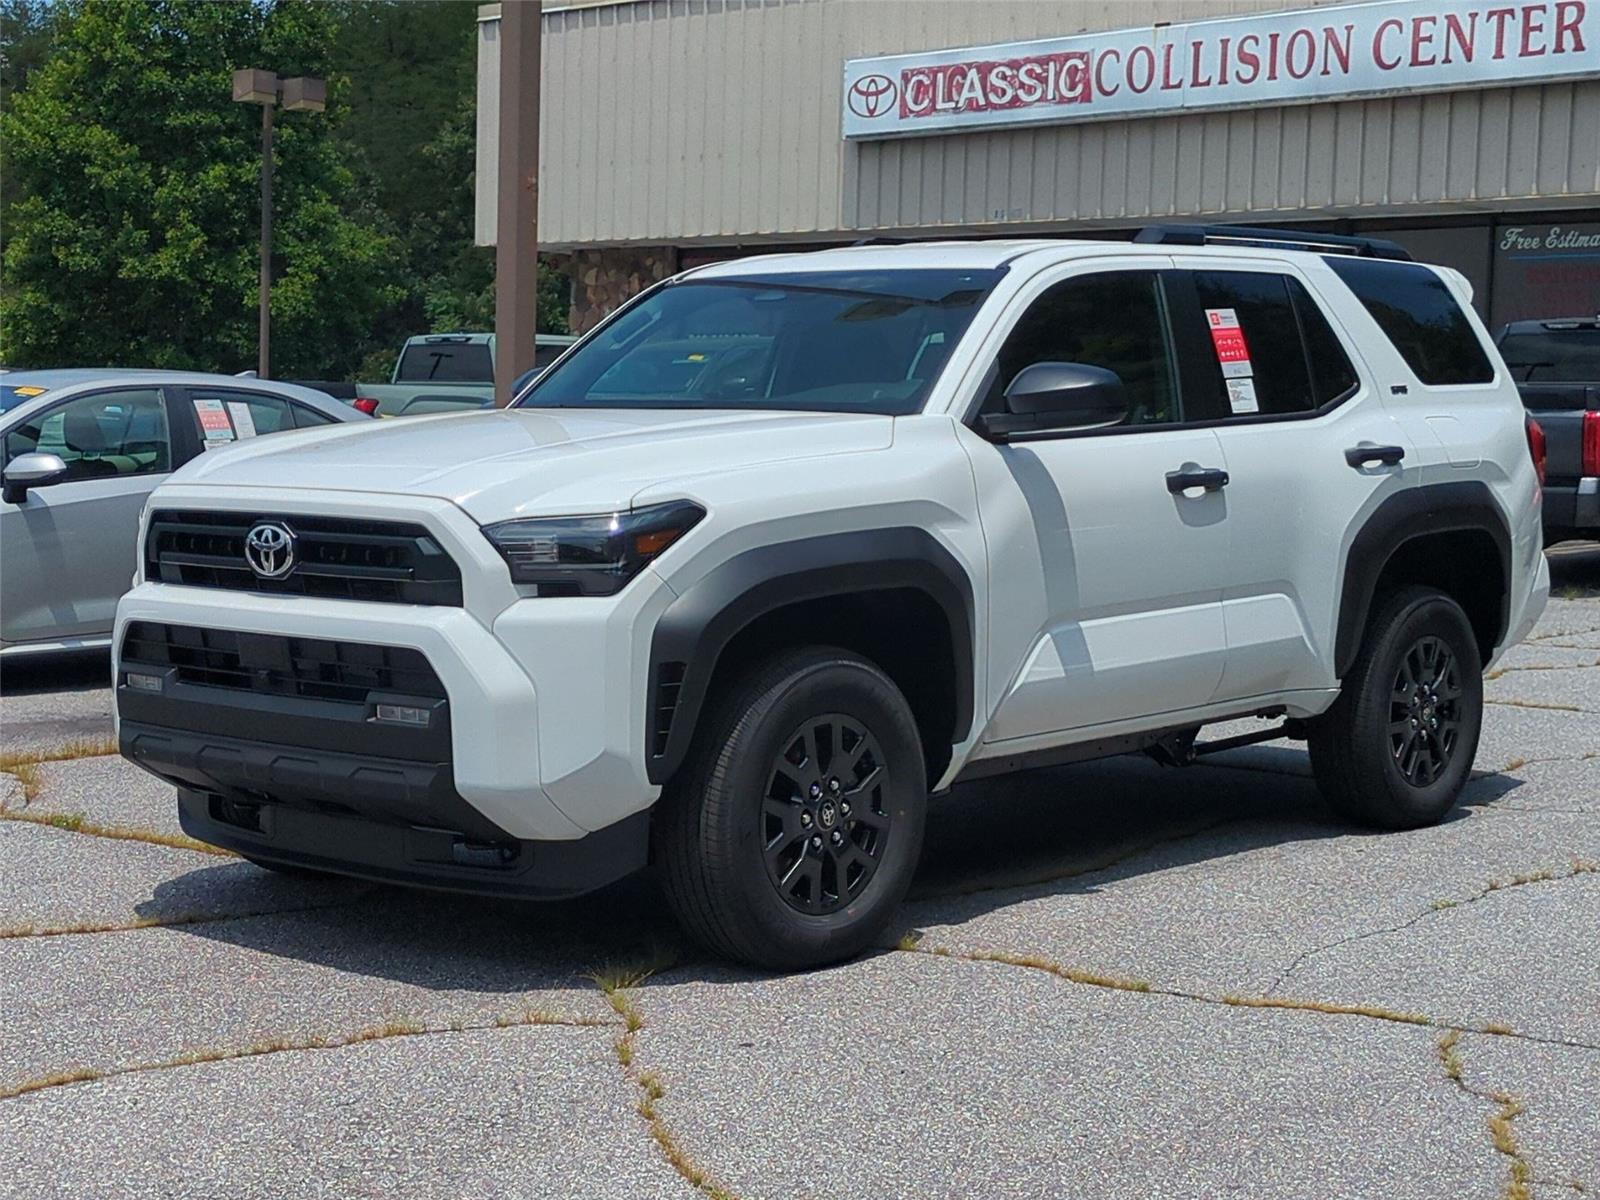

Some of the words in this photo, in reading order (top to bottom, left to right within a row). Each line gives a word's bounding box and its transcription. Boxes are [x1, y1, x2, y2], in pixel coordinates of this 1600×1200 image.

[905, 58, 1085, 112] CLASSIC
[1095, 25, 1354, 97] COLLISION
[1372, 1, 1587, 71] CENTER
[1500, 228, 1541, 250] Free
